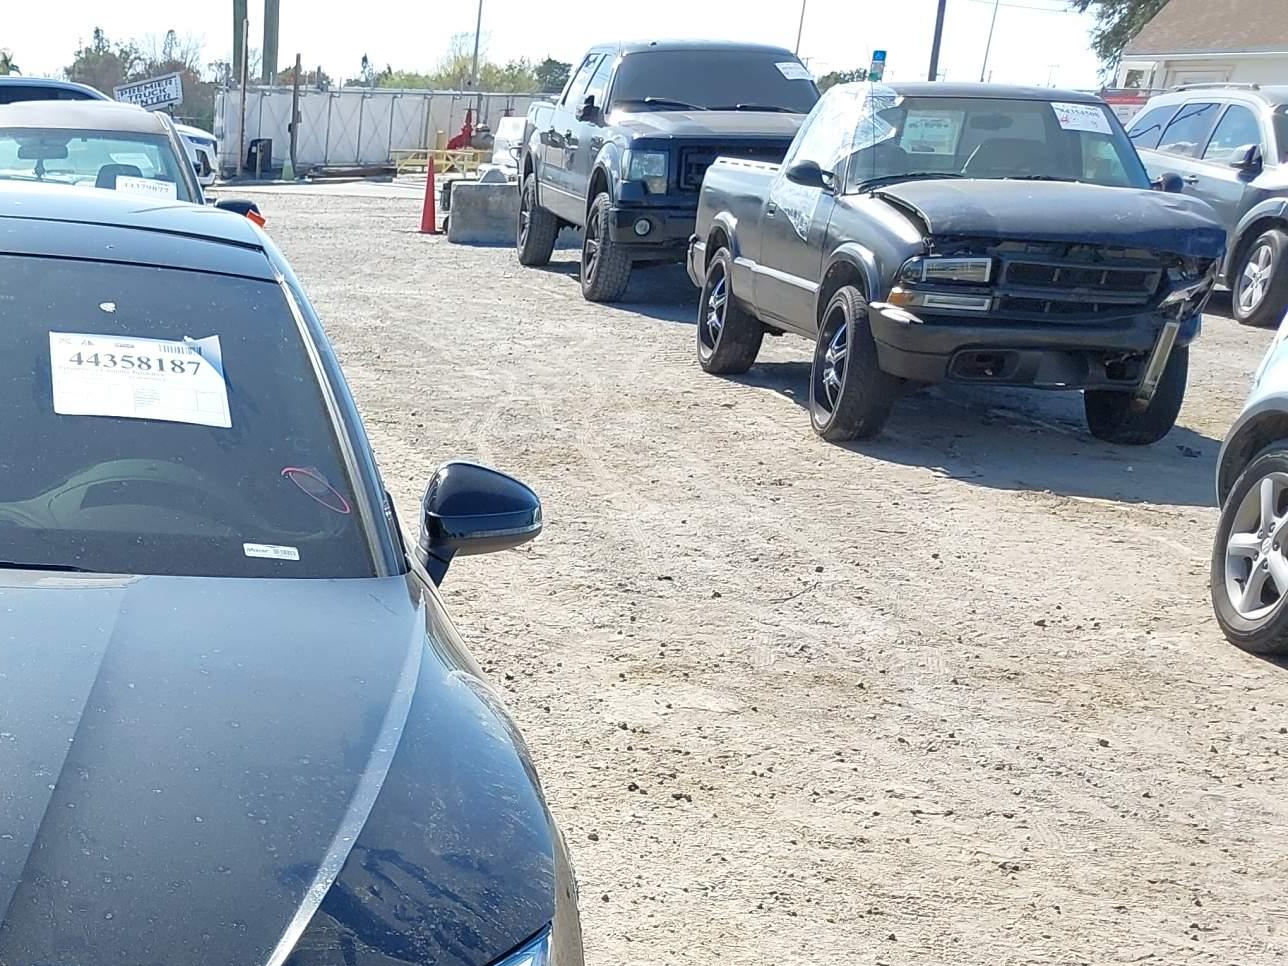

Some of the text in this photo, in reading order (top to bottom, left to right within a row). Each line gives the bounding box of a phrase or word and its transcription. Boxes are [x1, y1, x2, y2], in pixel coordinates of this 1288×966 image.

[120, 79, 172, 97] PREMIER
[127, 87, 167, 102] TRUCK
[139, 93, 171, 106] NTER
[68, 351, 201, 376] 44358187
